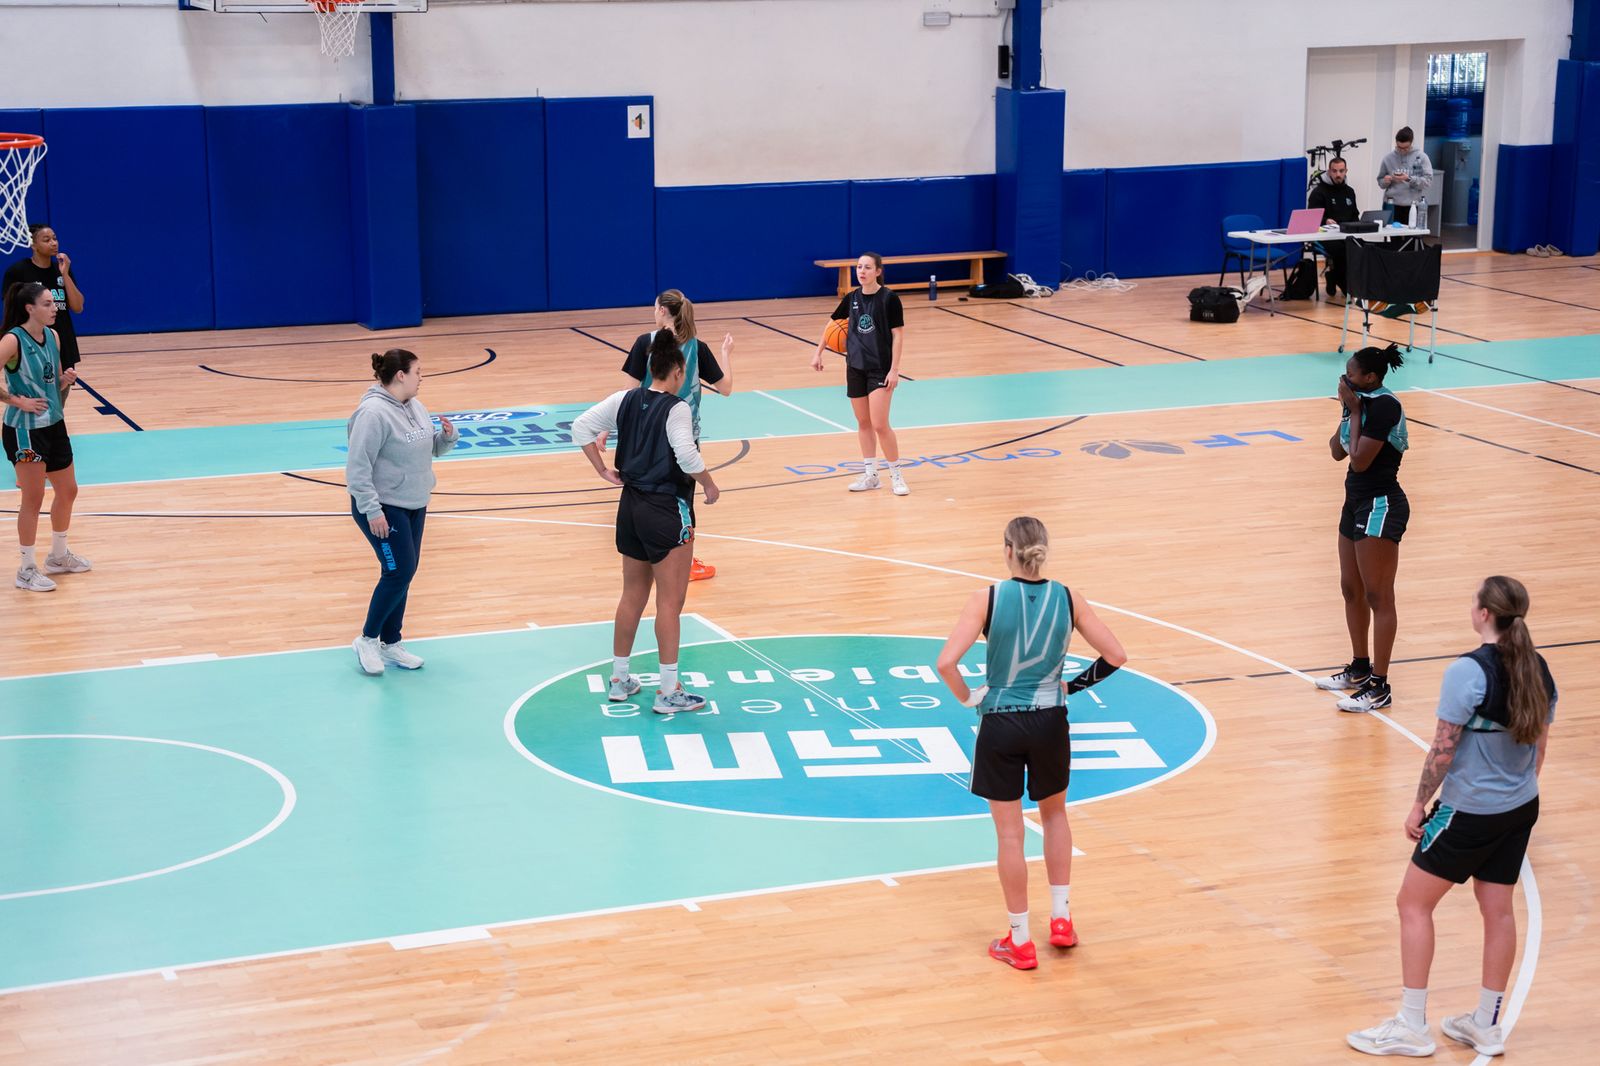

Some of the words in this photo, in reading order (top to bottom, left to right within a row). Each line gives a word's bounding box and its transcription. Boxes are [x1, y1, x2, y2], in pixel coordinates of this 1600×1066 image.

[50, 288, 66, 301] AB
[1192, 430, 1304, 449] LF
[784, 446, 1061, 476] endesa
